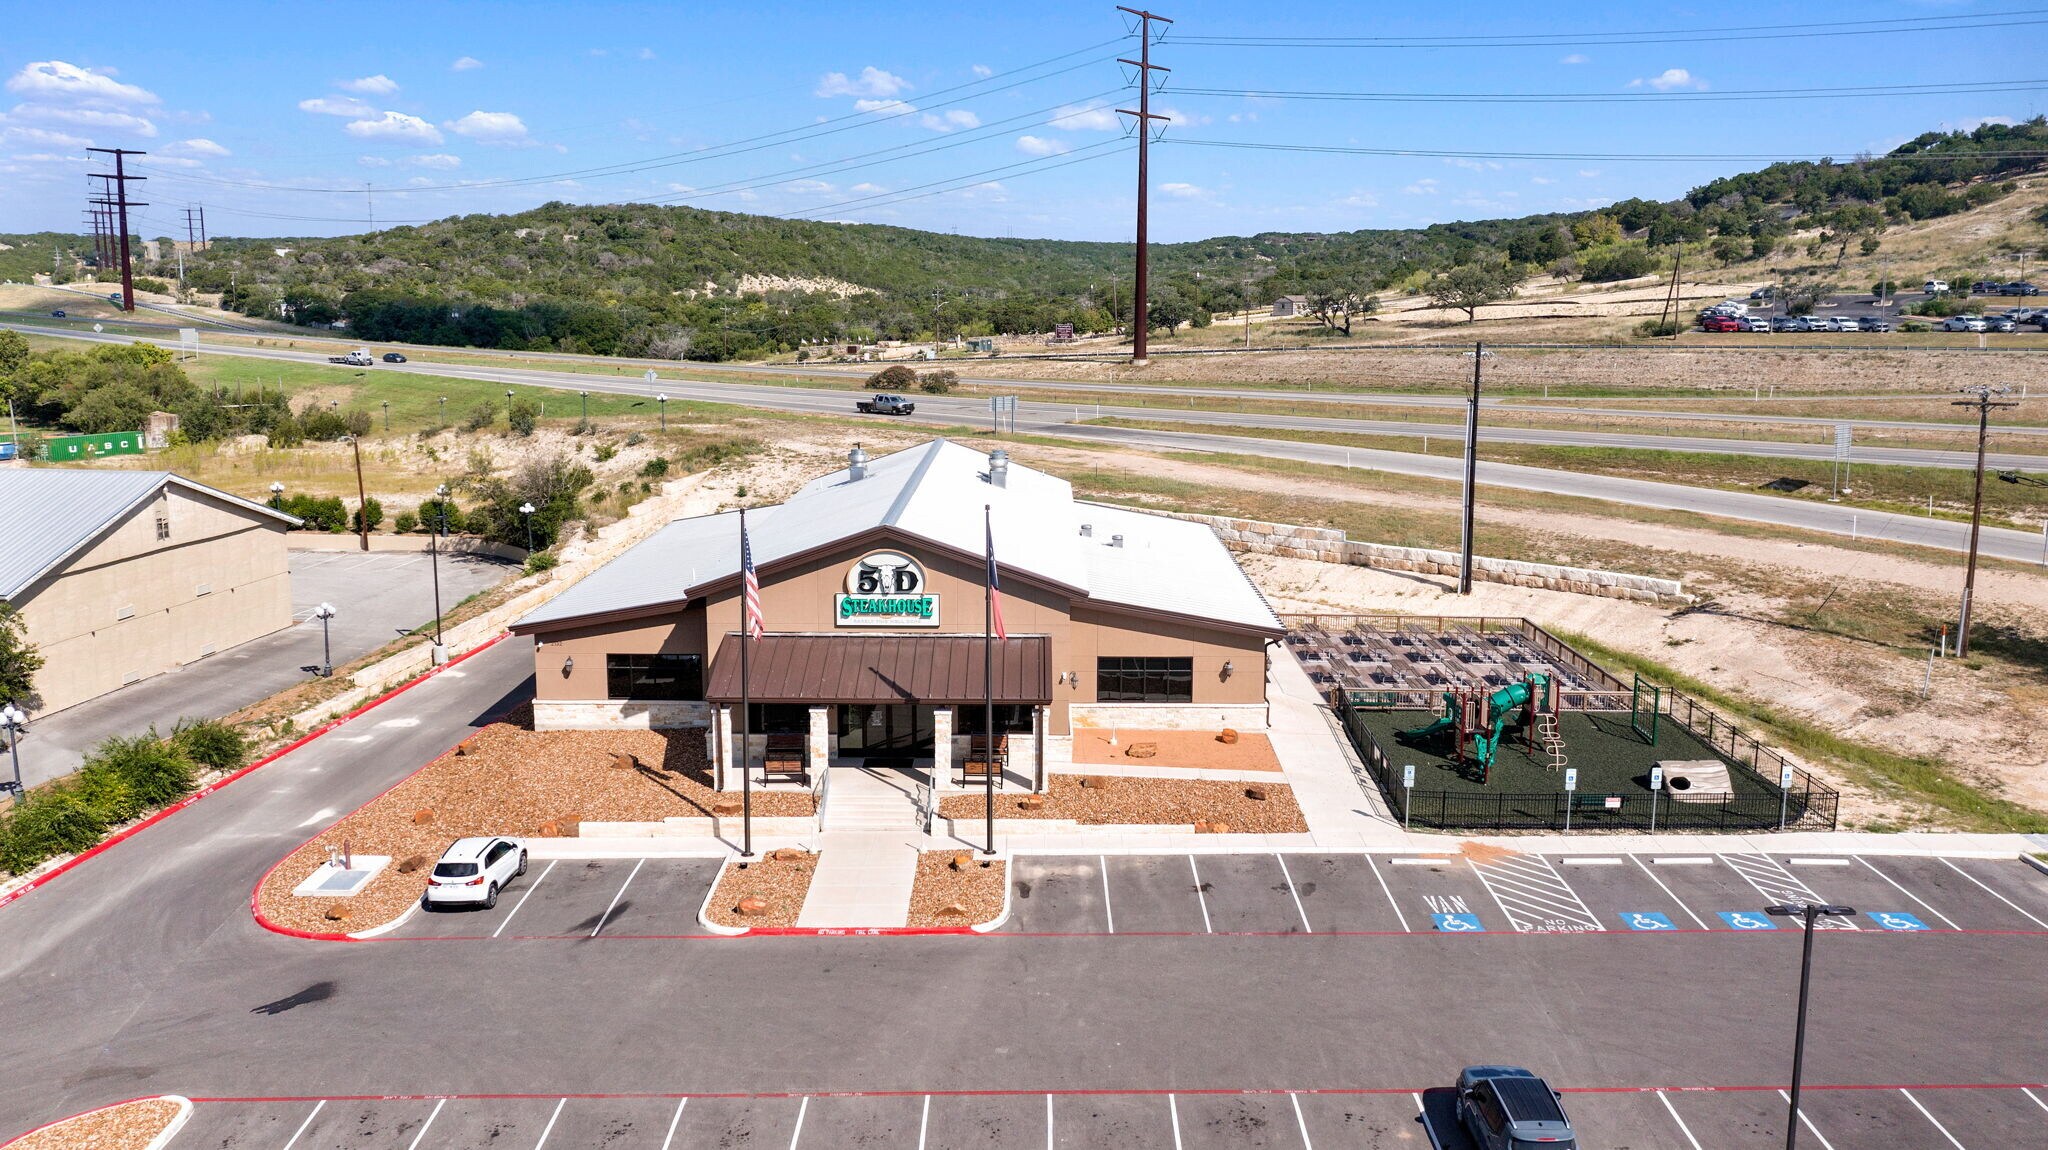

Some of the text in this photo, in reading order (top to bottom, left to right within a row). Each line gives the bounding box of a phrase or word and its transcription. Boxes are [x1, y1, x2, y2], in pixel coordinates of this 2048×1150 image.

[858, 569, 919, 593] 5 D
[841, 596, 933, 617] STEAKHOUSE
[1422, 895, 1471, 913] VAN
